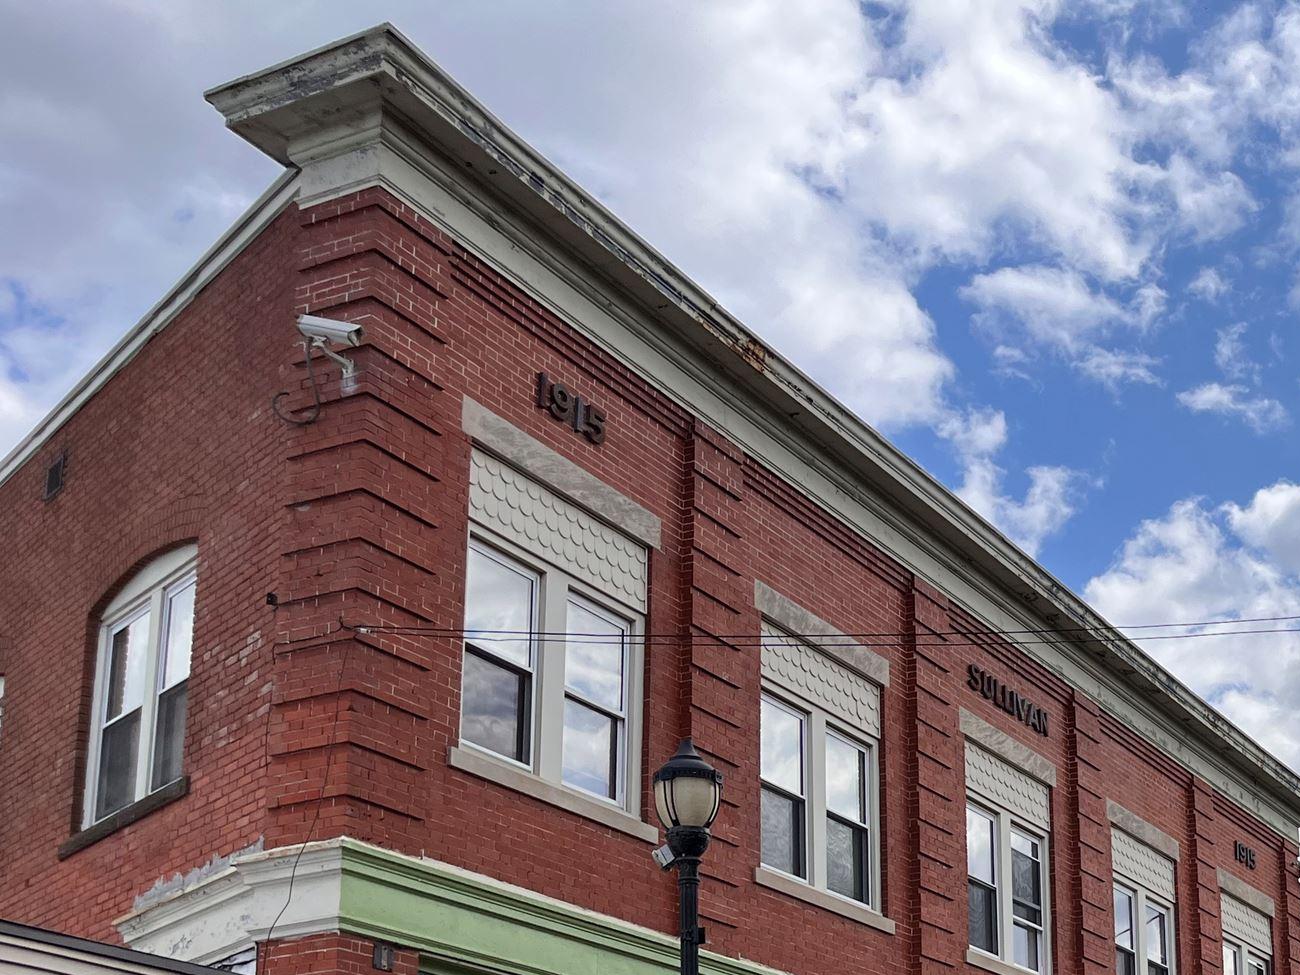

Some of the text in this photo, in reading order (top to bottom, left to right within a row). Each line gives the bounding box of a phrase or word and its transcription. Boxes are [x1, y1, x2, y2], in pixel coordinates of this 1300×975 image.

[536, 372, 606, 445] 1915
[967, 663, 1049, 737] SULLIVAN
[1233, 839, 1257, 870] 1915
